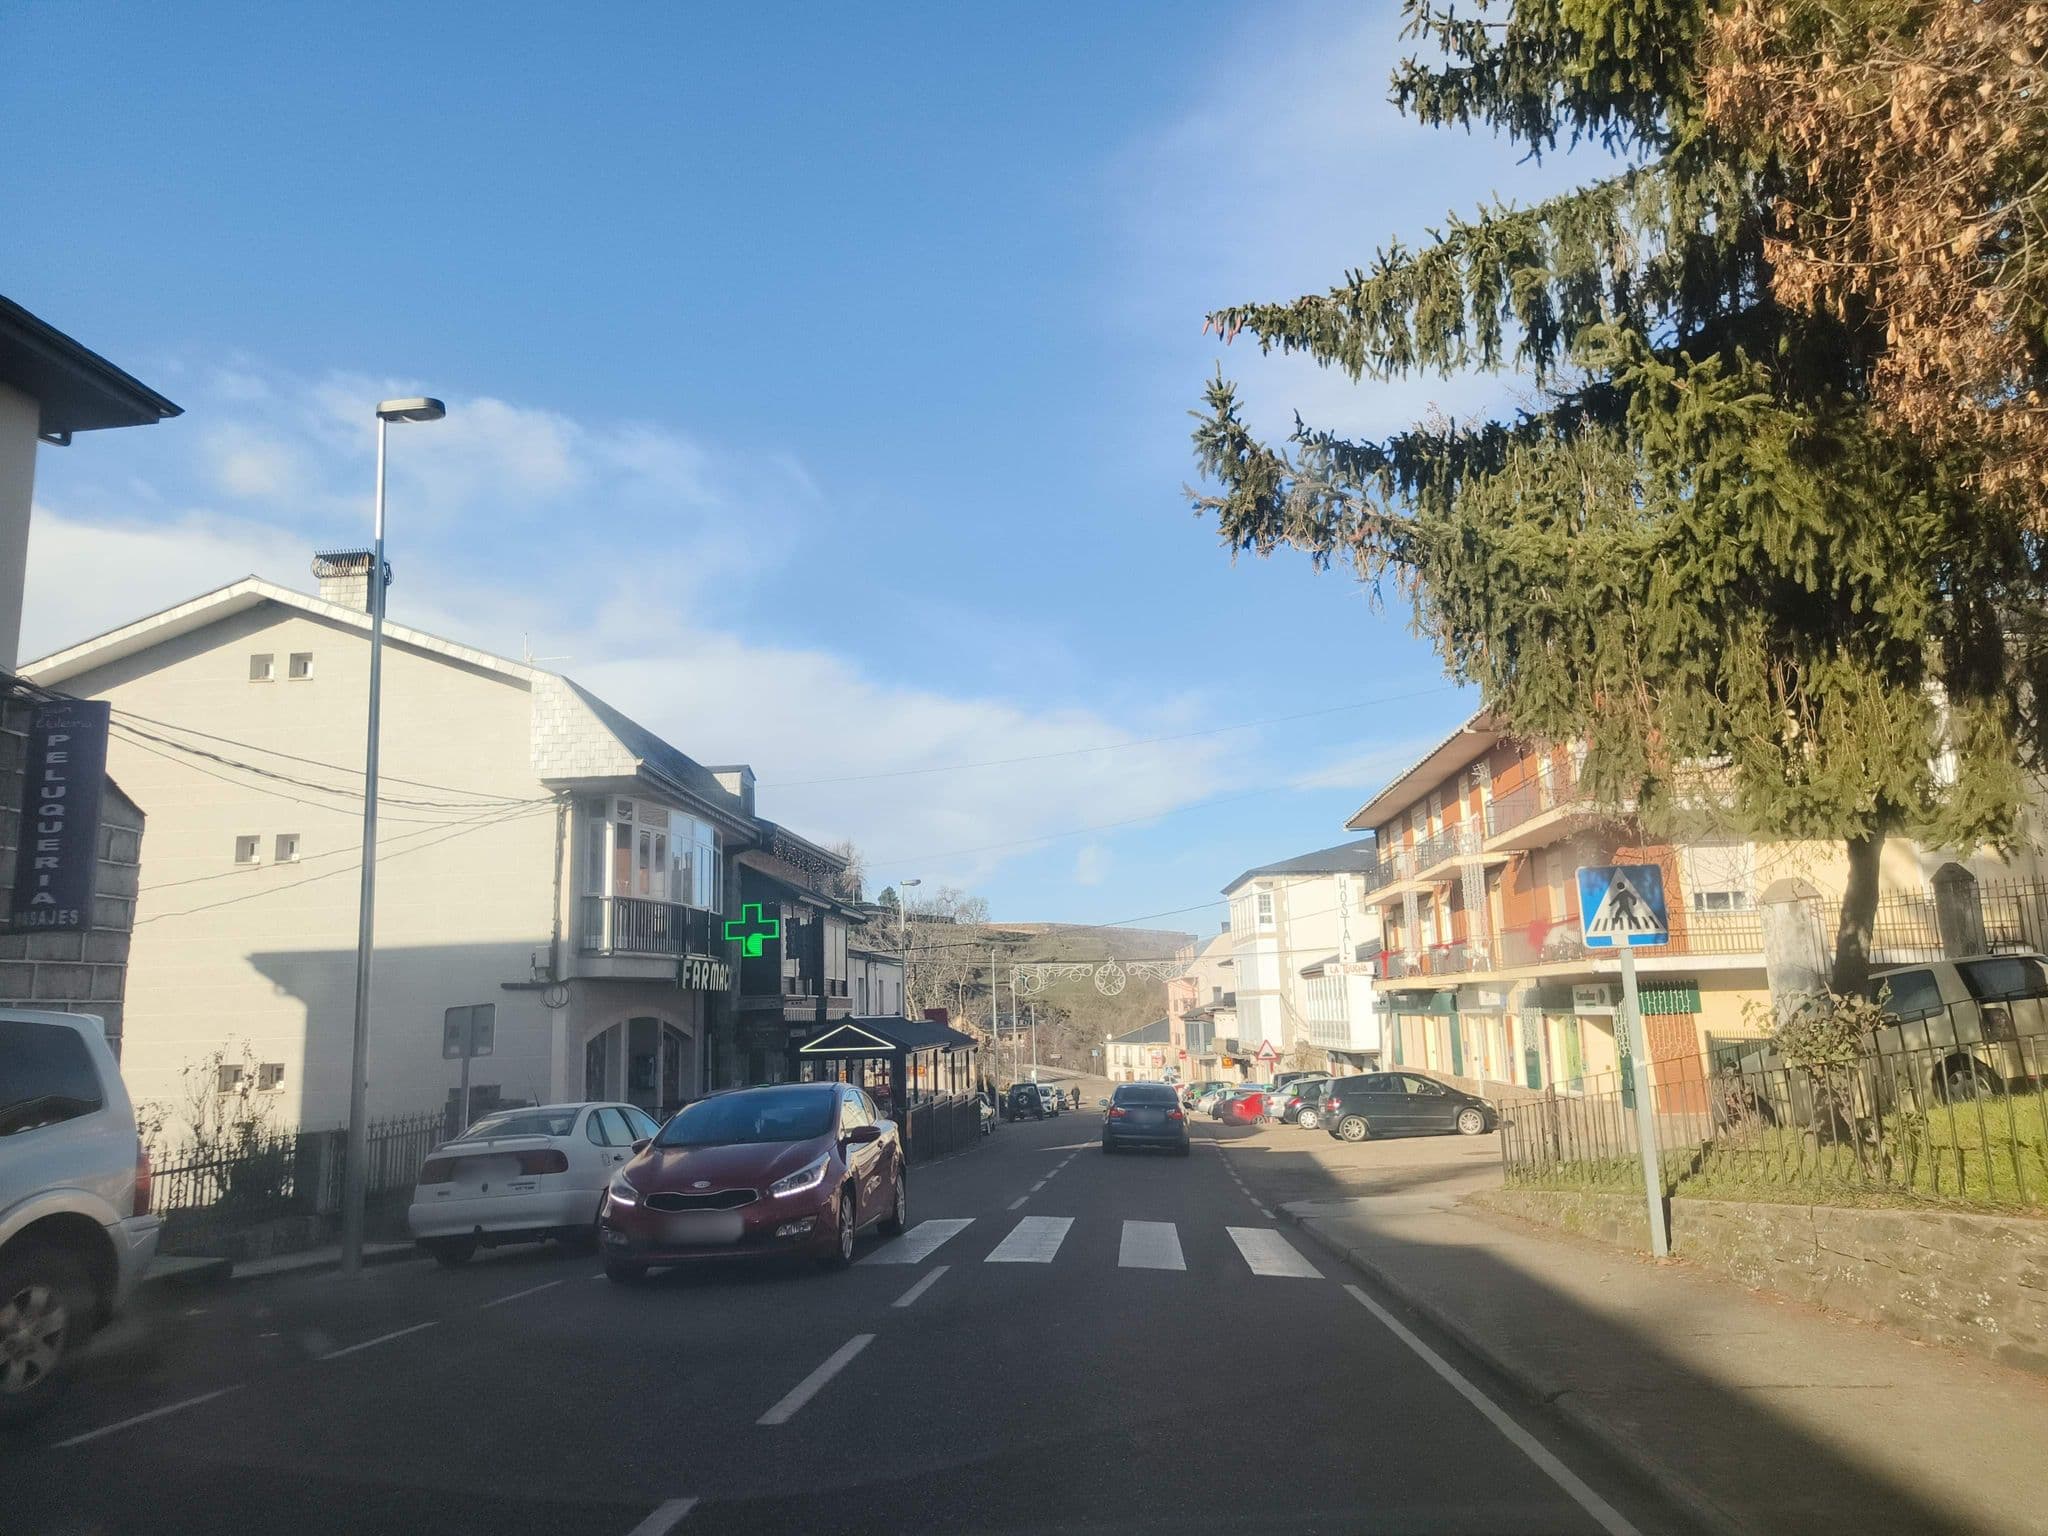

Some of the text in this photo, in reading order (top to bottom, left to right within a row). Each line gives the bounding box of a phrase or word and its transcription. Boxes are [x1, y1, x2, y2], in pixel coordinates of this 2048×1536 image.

[31, 734, 71, 904] PELUQUERIA
[14, 908, 79, 926] SAJES
[1338, 876, 1351, 955] HOSTAL
